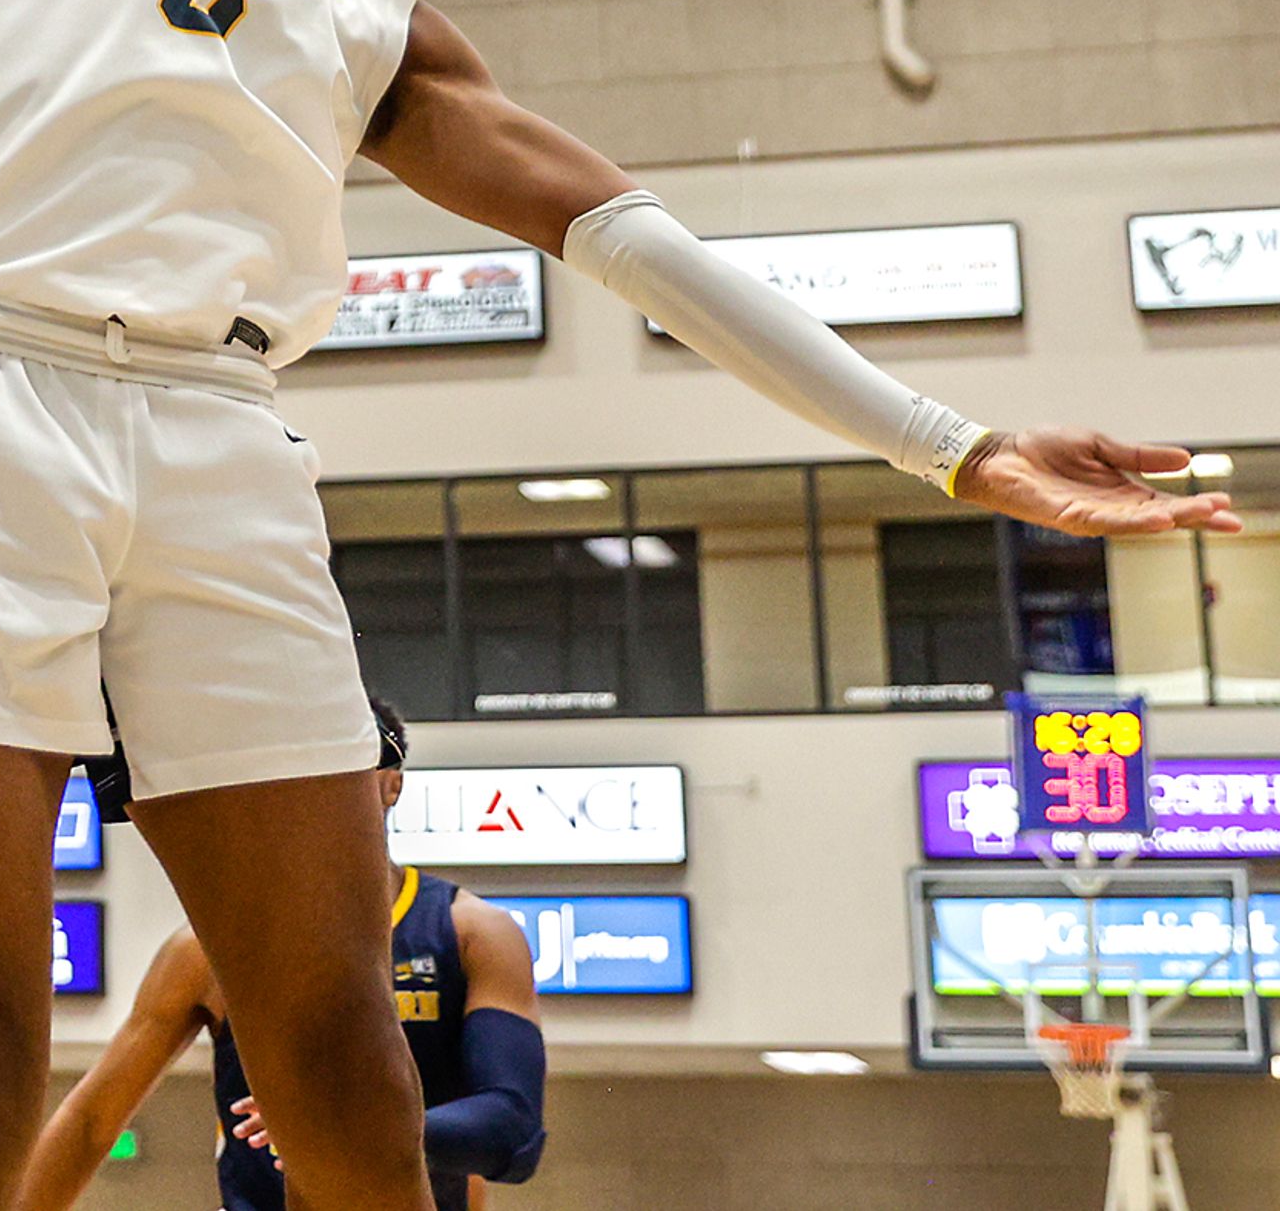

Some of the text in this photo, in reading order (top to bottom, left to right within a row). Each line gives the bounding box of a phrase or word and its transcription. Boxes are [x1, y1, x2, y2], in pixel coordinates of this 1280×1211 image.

[344, 266, 444, 296] EAT
[392, 778, 658, 833] LLIANCE
[1041, 751, 1130, 825] 30
